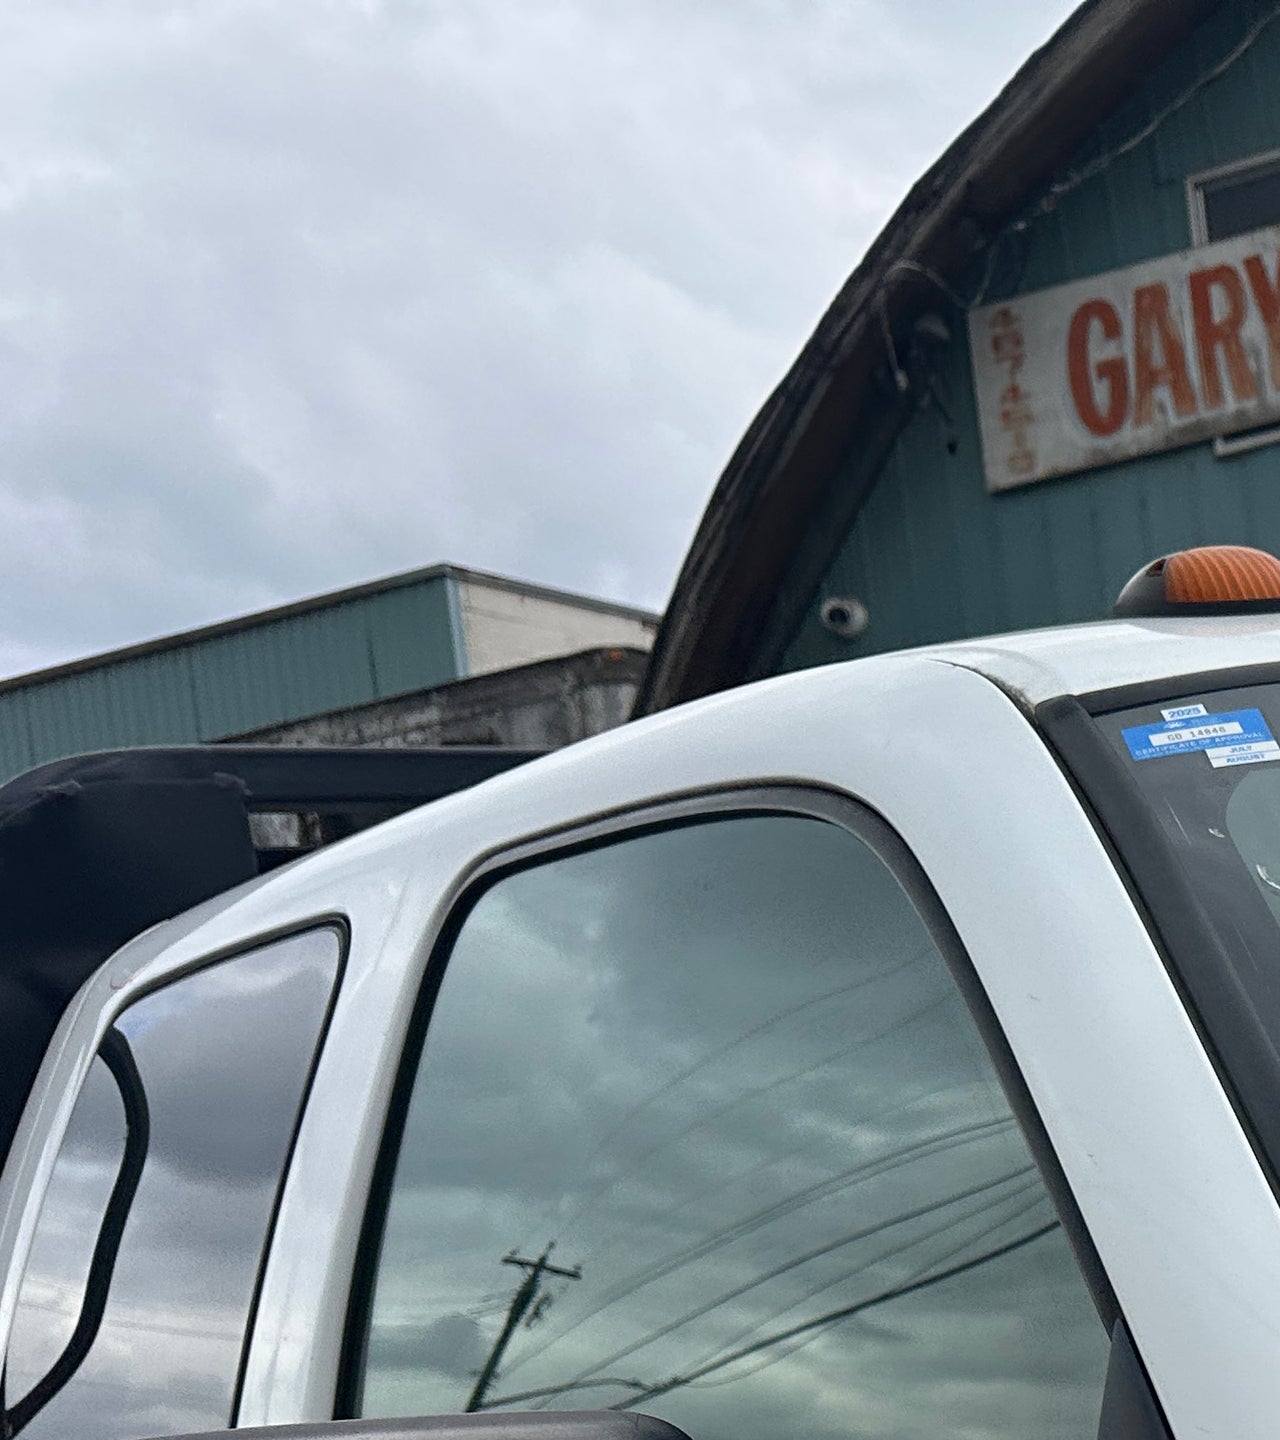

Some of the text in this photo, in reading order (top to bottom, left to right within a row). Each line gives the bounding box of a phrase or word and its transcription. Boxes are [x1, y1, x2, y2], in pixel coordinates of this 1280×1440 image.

[1135, 740, 1197, 757] CERTIFICATE
[1215, 732, 1265, 744] APPROVAL
[1226, 753, 1265, 763] AUGUST
